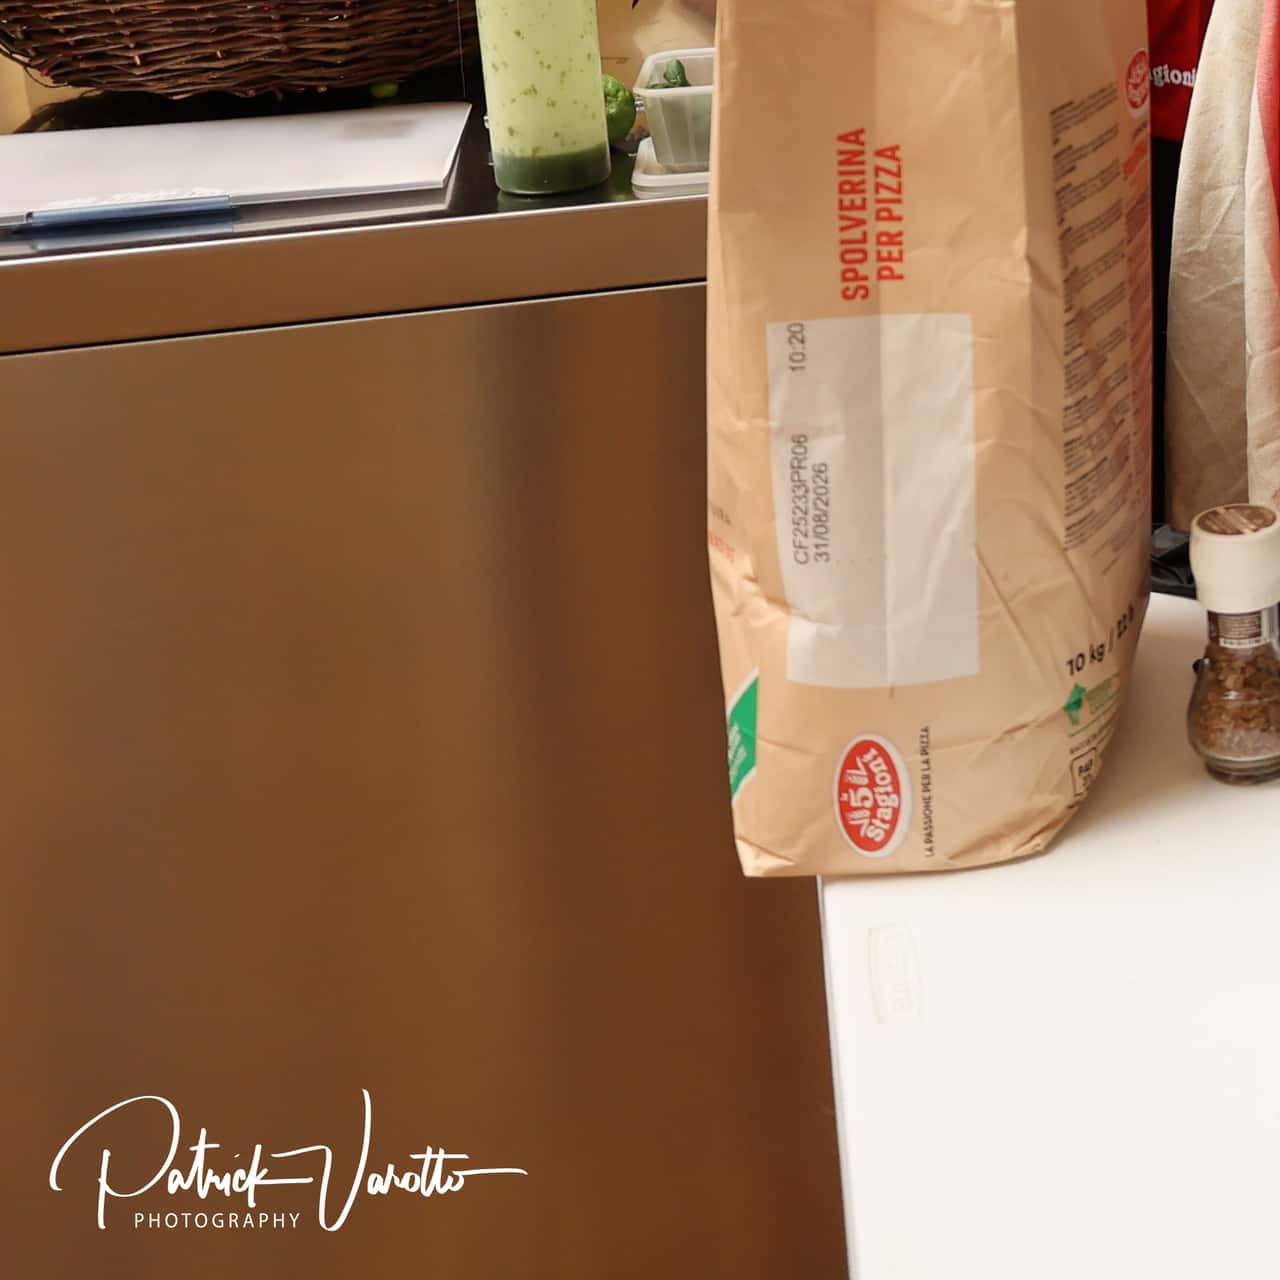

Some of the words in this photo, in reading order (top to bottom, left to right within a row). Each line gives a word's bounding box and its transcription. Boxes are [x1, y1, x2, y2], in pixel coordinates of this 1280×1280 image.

[836, 127, 869, 301] SPOLVERINA
[874, 144, 903, 222] PIZZA
[876, 230, 904, 281] PER
[787, 322, 806, 372] 10:20
[790, 433, 809, 565] CF25233PR06
[812, 462, 831, 563] 31/08/2026
[1066, 652, 1085, 676] 10
[1089, 643, 1106, 663] kg
[849, 786, 874, 808] 5
[863, 747, 899, 842] Stagioni
